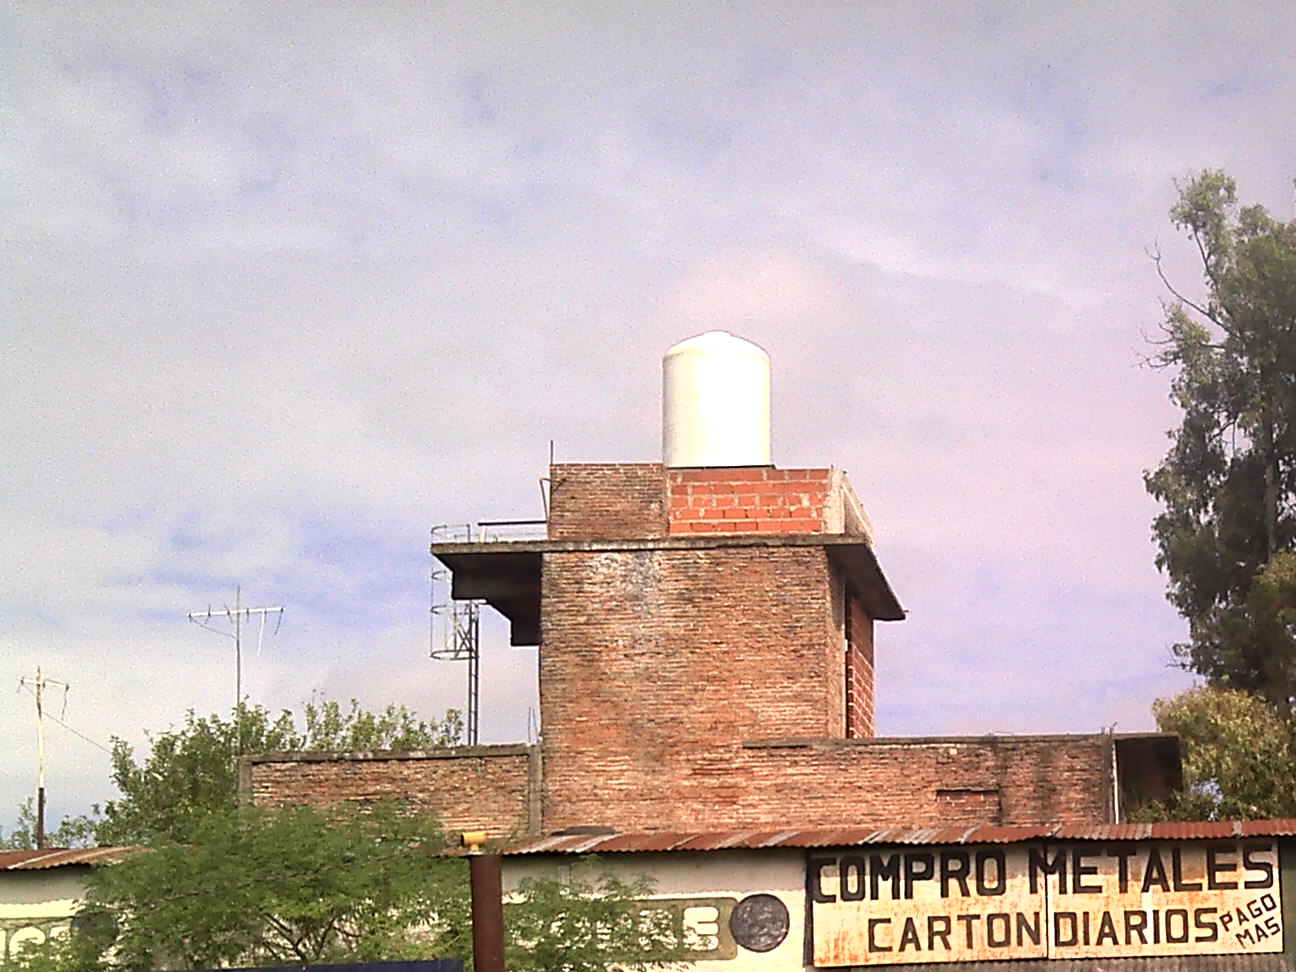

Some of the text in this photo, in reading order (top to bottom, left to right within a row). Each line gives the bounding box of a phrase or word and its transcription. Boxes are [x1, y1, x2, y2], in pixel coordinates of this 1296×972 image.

[811, 841, 1274, 904] COMPRO METALES
[868, 908, 1218, 953] CARTON DIARIOS
[1219, 893, 1277, 932] PAGO
[1235, 916, 1280, 949] MAS
